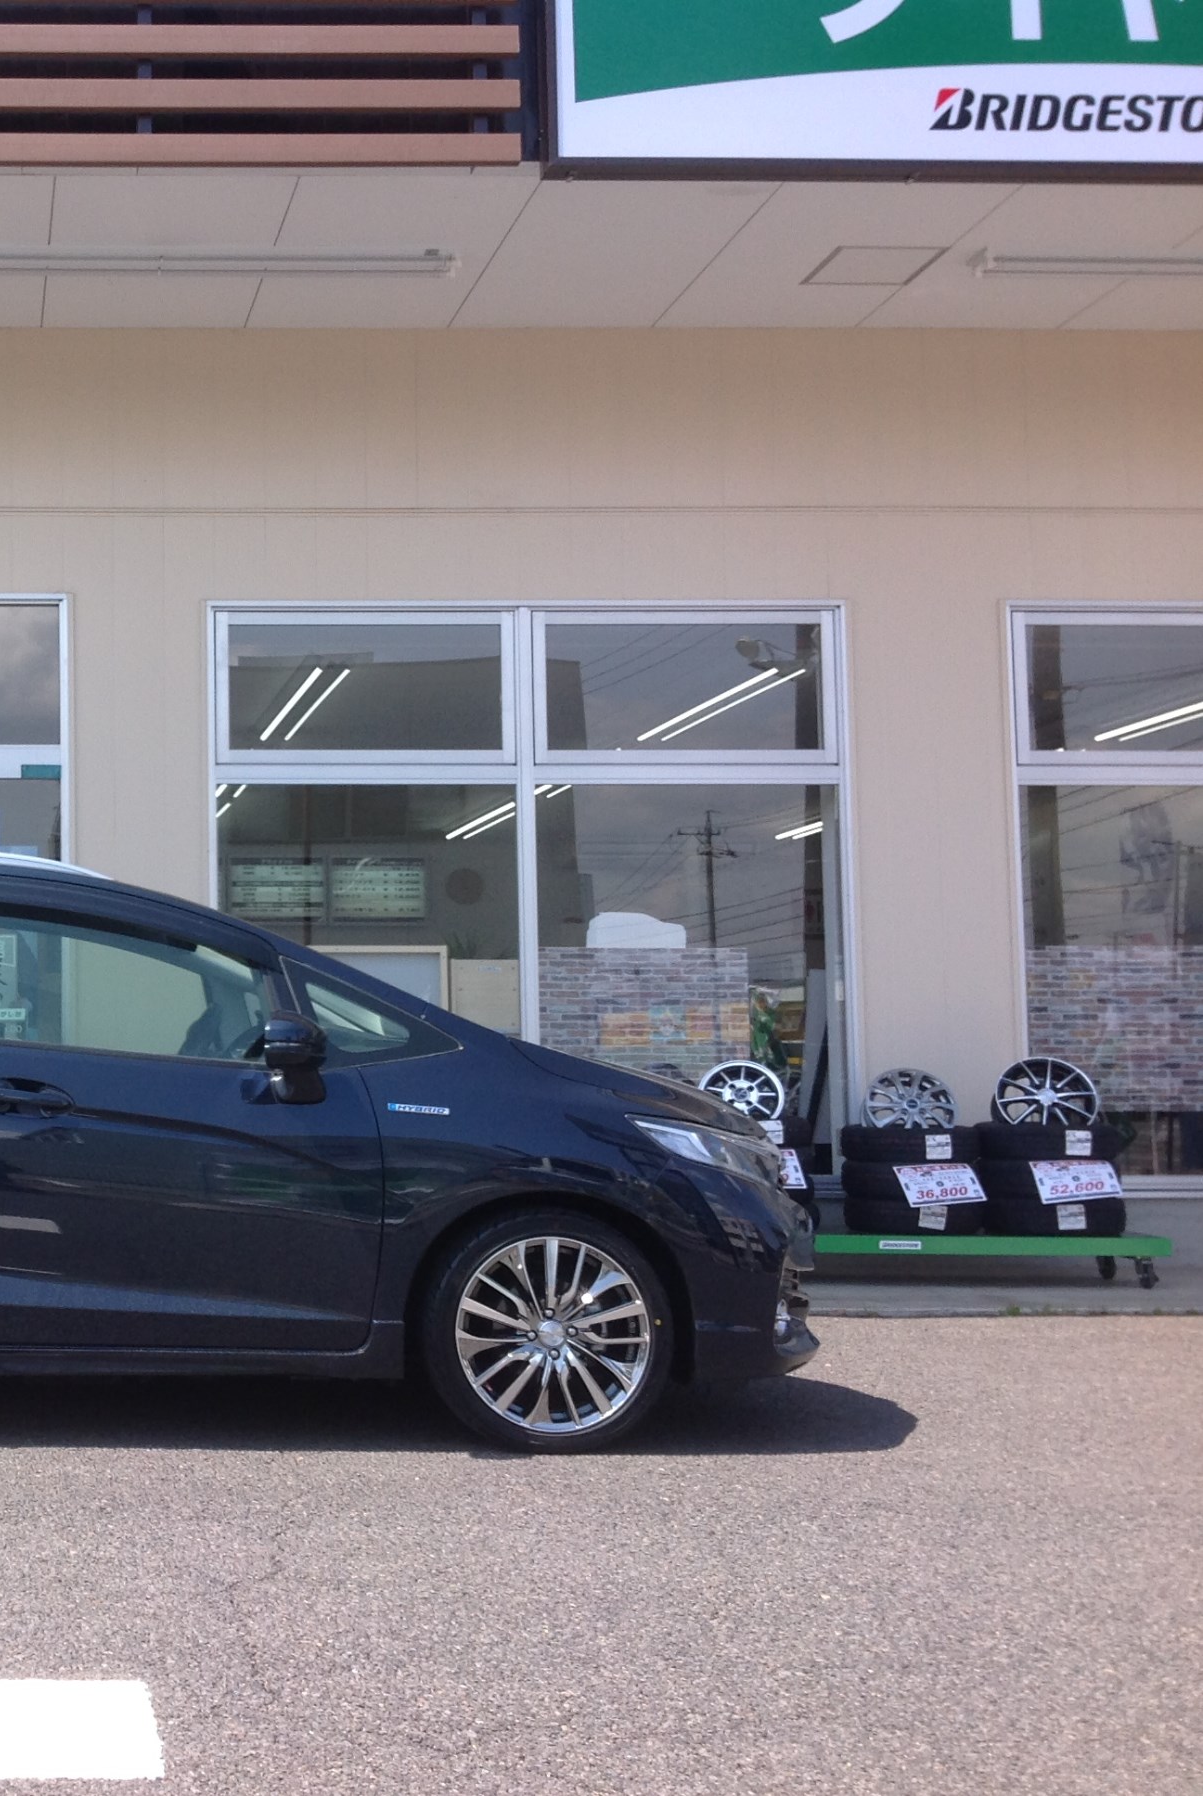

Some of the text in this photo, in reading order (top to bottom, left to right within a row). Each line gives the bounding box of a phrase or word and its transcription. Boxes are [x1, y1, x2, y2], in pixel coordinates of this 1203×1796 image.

[398, 1104, 447, 1115] HYBRID
[916, 1186, 968, 1200] 36,800
[1049, 1181, 1105, 1195] 52,600
